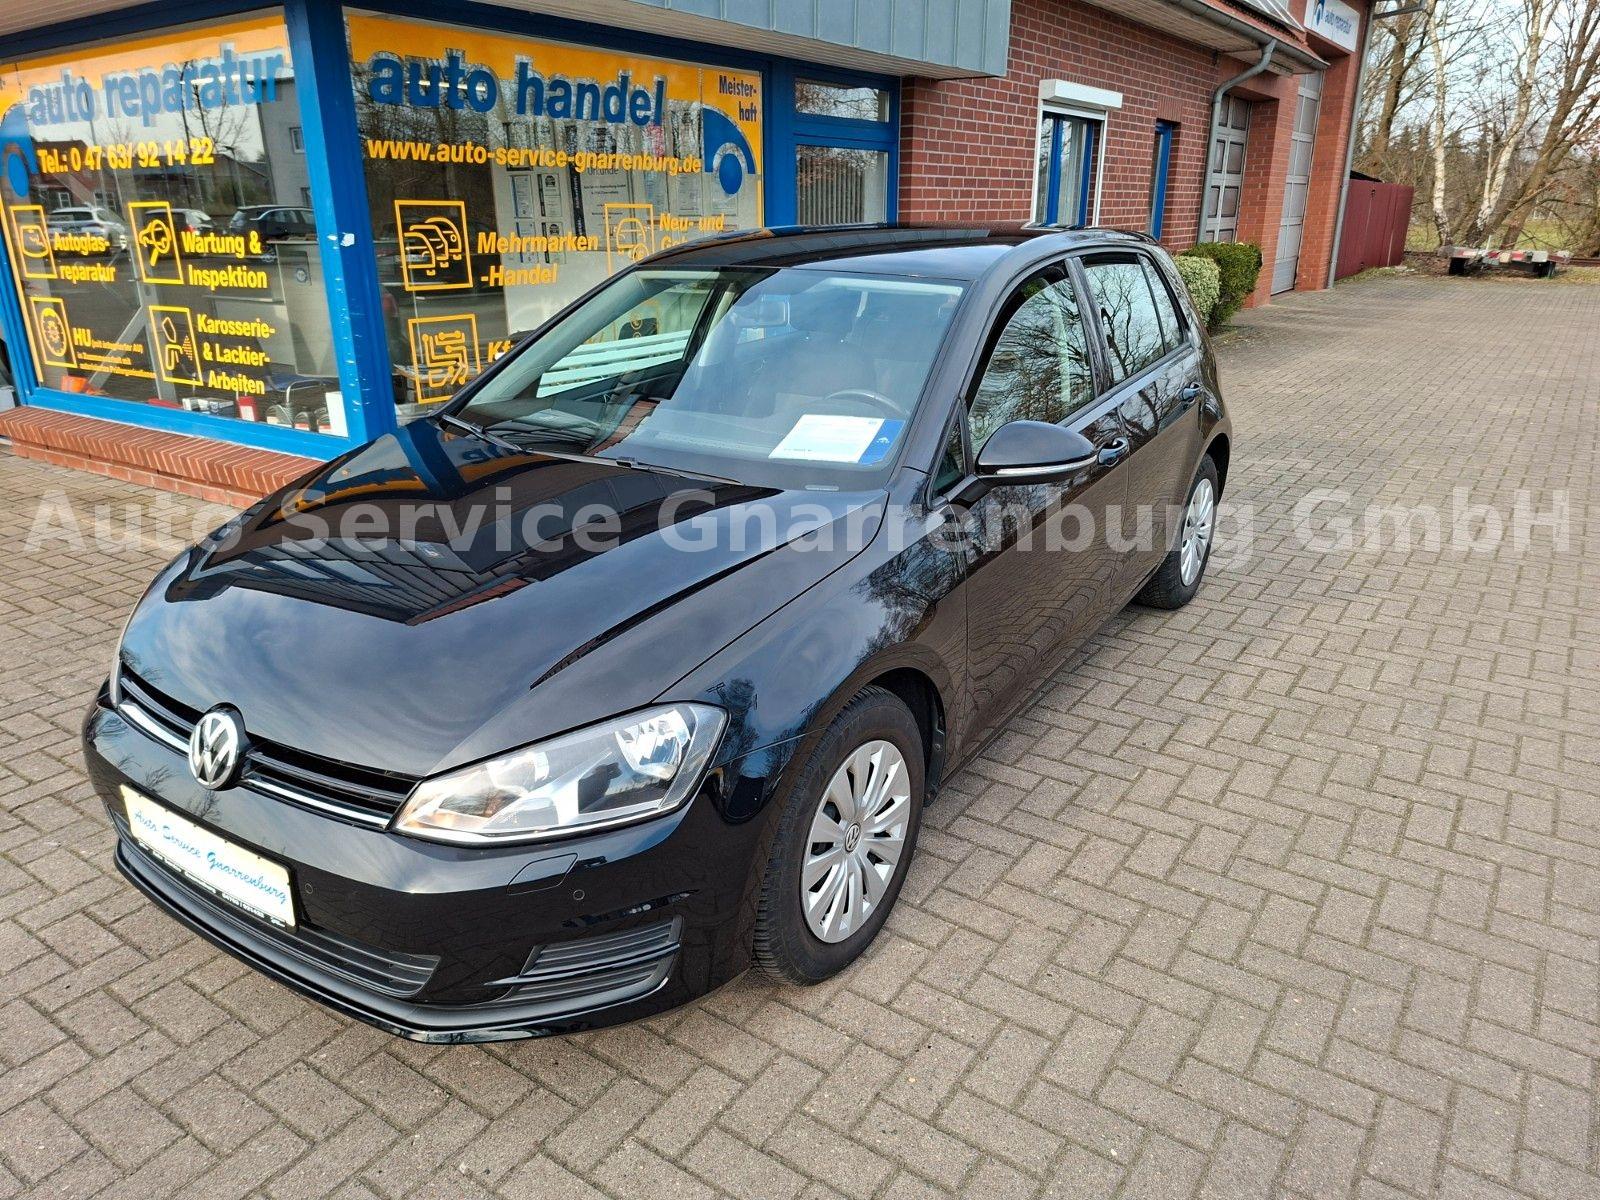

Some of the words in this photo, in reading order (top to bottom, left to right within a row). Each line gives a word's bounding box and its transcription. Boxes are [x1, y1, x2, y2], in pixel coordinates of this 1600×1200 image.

[29, 74, 95, 126] auto
[104, 50, 284, 127] reparatur
[370, 55, 497, 113] auto
[516, 61, 664, 126] handel
[719, 75, 757, 97] Meister-
[738, 101, 757, 122] haft
[38, 148, 68, 173] Tel.:
[70, 147, 81, 171] 0
[85, 144, 102, 170] 47
[107, 142, 132, 169] 63/
[138, 141, 159, 167] 92
[163, 140, 185, 166] 14
[190, 138, 214, 164] 22
[367, 138, 702, 176] www.auto-service-gnarrenburg.de
[659, 212, 694, 232] Neu-
[698, 212, 725, 232] und
[54, 233, 110, 255] Autoglas-
[181, 231, 246, 258] Wartung
[249, 231, 262, 254] &
[477, 231, 598, 255] Mehrmarken
[60, 263, 115, 283] reparatur
[188, 264, 268, 290] Inspektion
[480, 262, 558, 287] -Handel
[73, 328, 92, 347] HU
[197, 313, 276, 339] Karosserie-
[203, 343, 213, 361] &
[215, 345, 271, 368] Lackier-
[208, 370, 266, 395] Arbeiten
